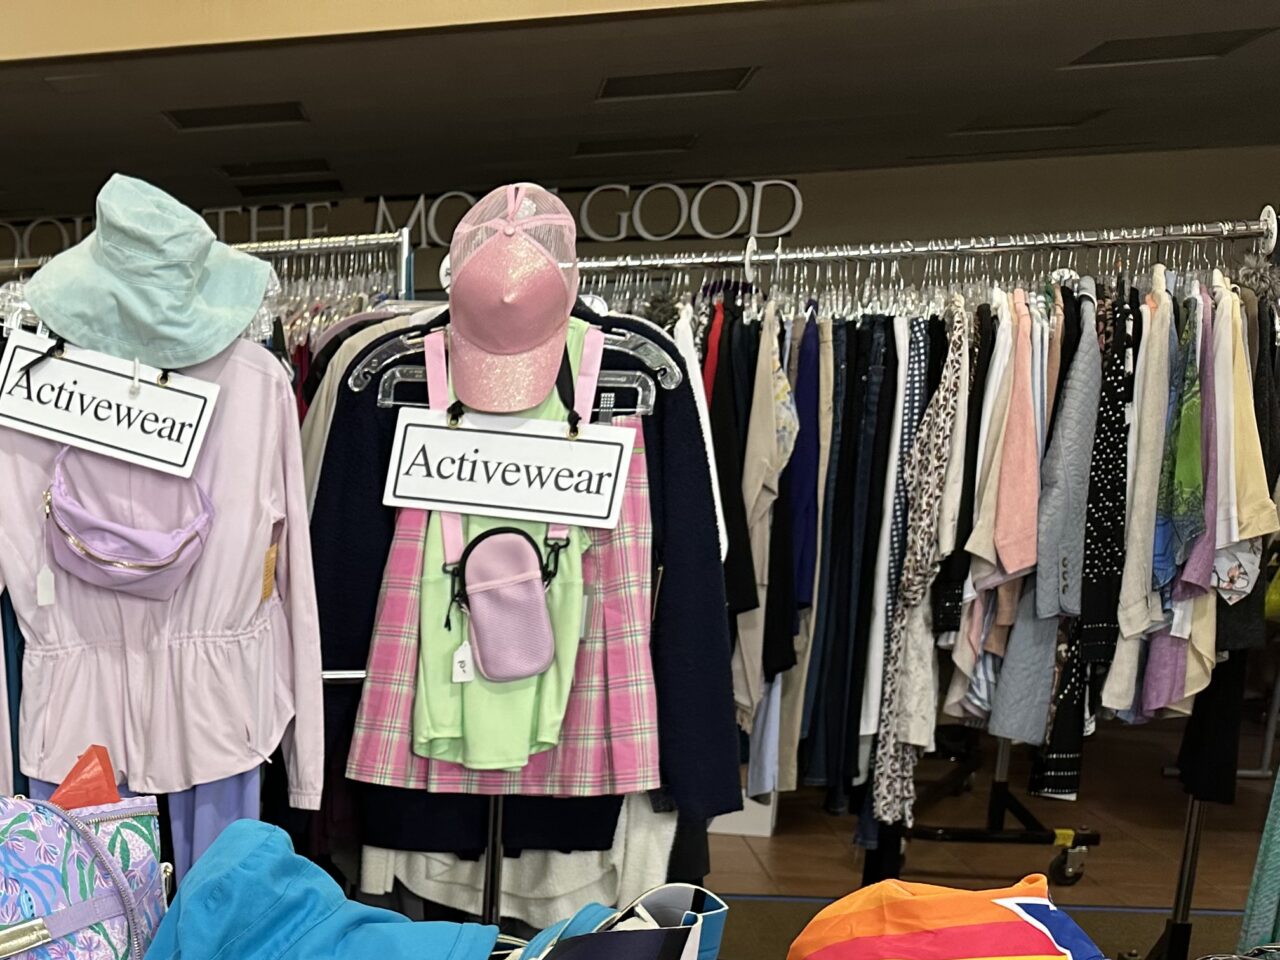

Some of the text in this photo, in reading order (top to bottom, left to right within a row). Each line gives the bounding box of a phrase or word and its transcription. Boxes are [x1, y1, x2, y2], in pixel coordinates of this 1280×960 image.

[579, 179, 803, 242] GOOD
[5, 366, 194, 445] Activewear
[402, 443, 613, 496] Activewear
